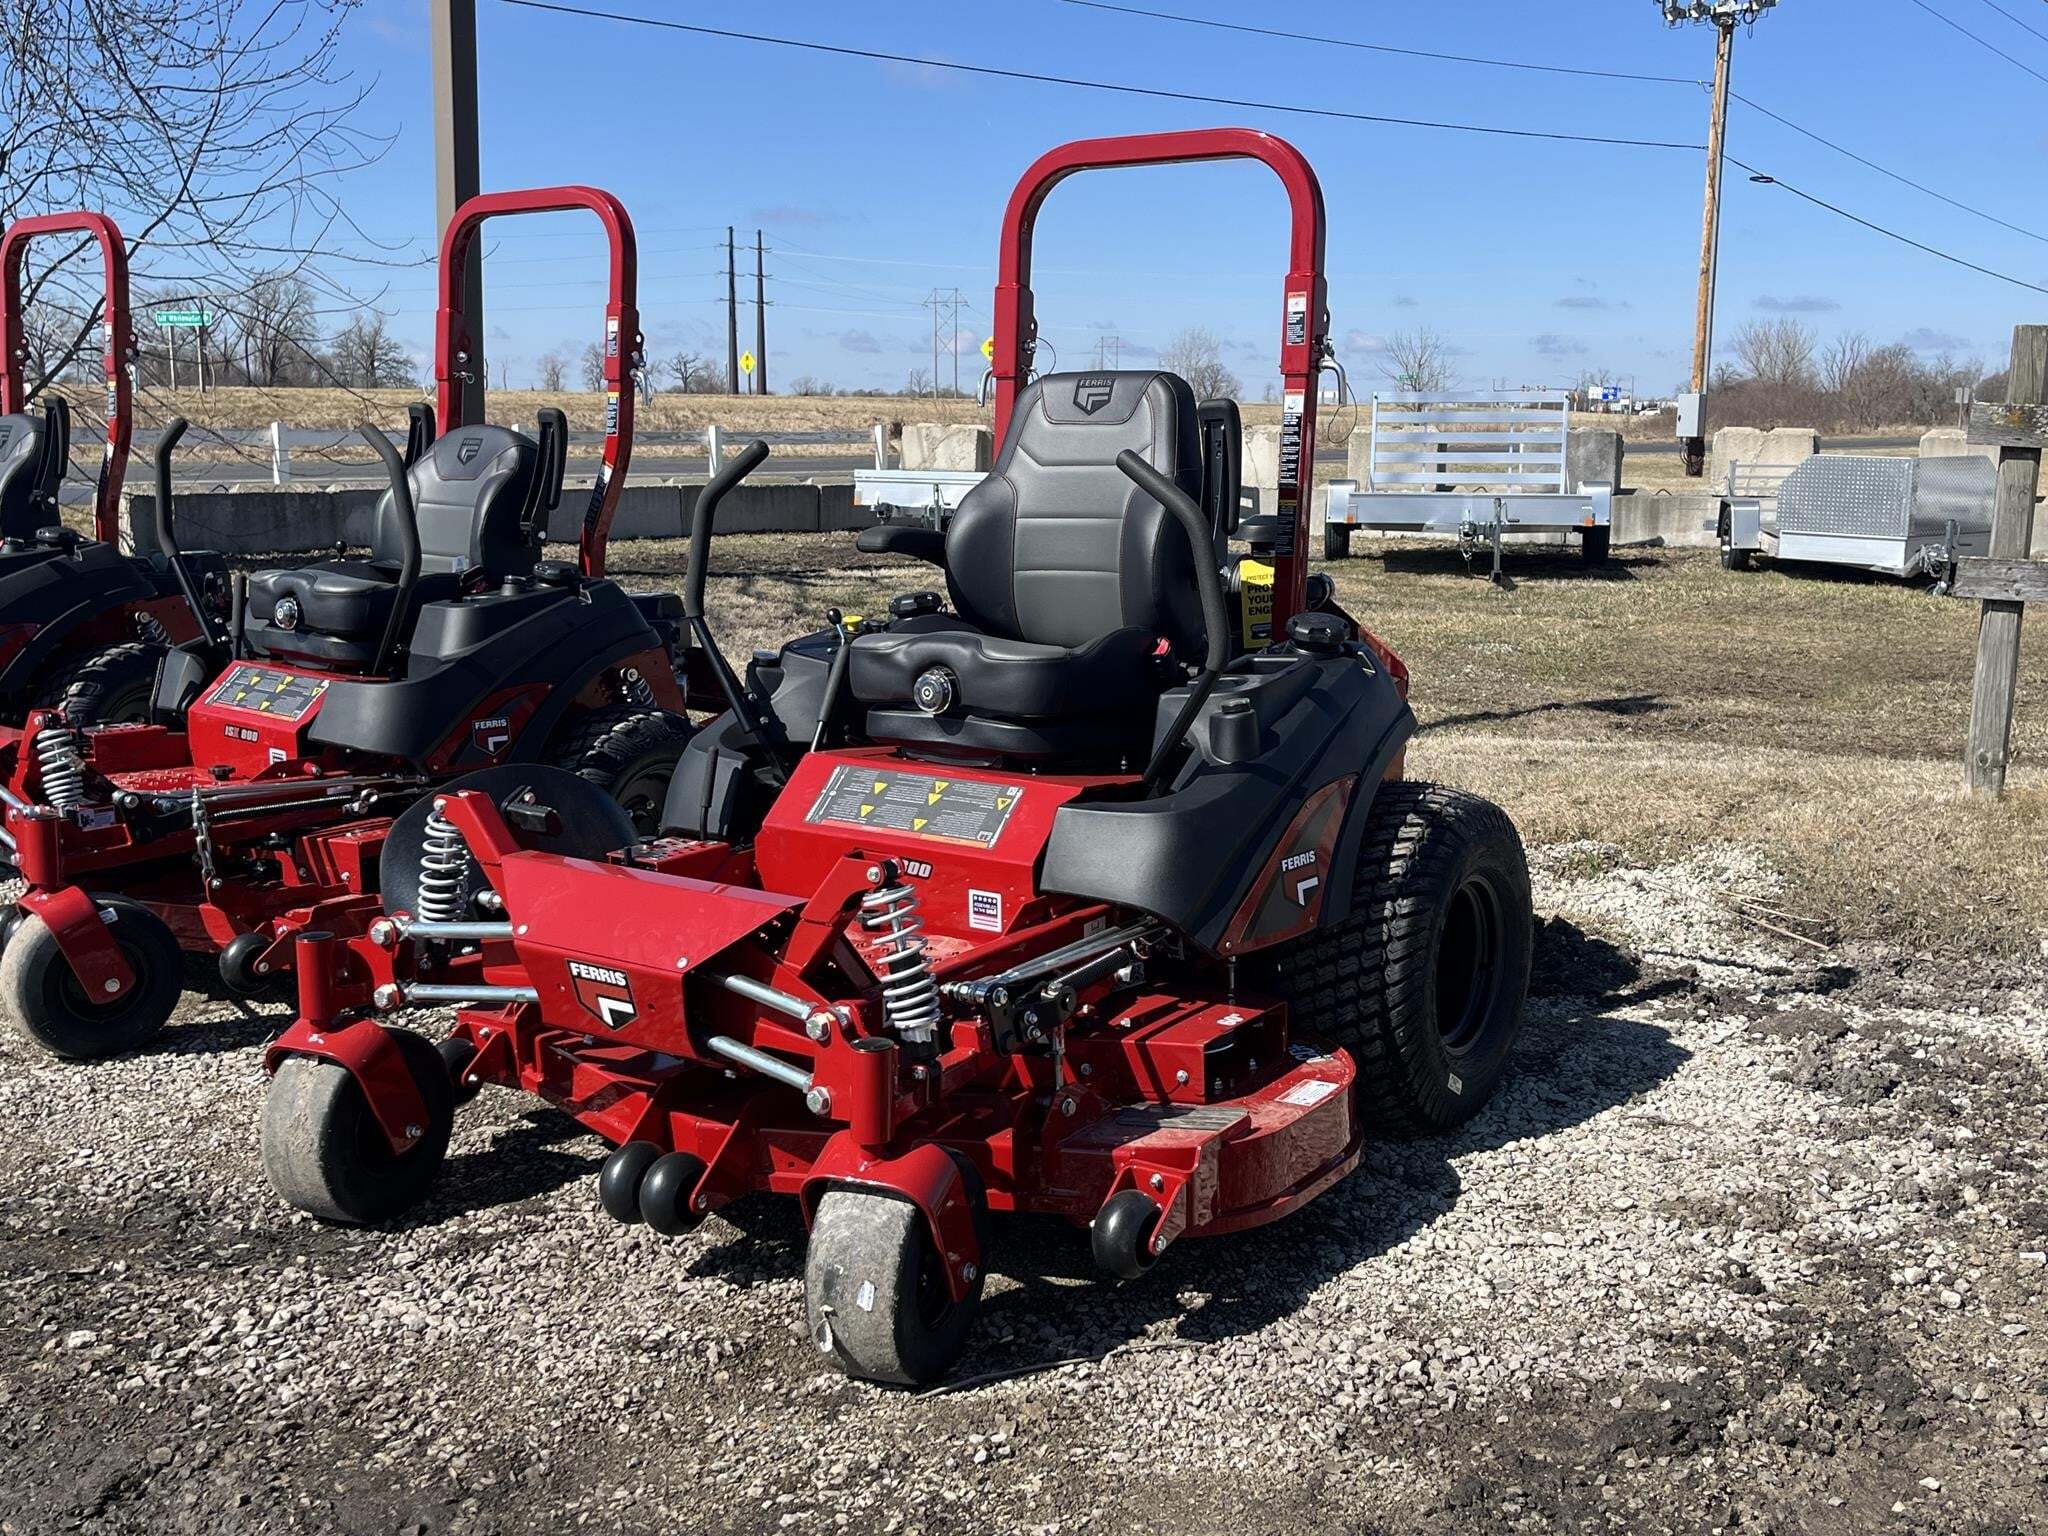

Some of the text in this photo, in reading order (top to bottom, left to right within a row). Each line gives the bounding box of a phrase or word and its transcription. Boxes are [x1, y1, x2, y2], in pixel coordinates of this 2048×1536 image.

[1080, 379, 1112, 387] FERRIS
[475, 719, 507, 730] FERRIS
[1282, 850, 1316, 872] FERRIS
[569, 962, 627, 987] FERRIS
